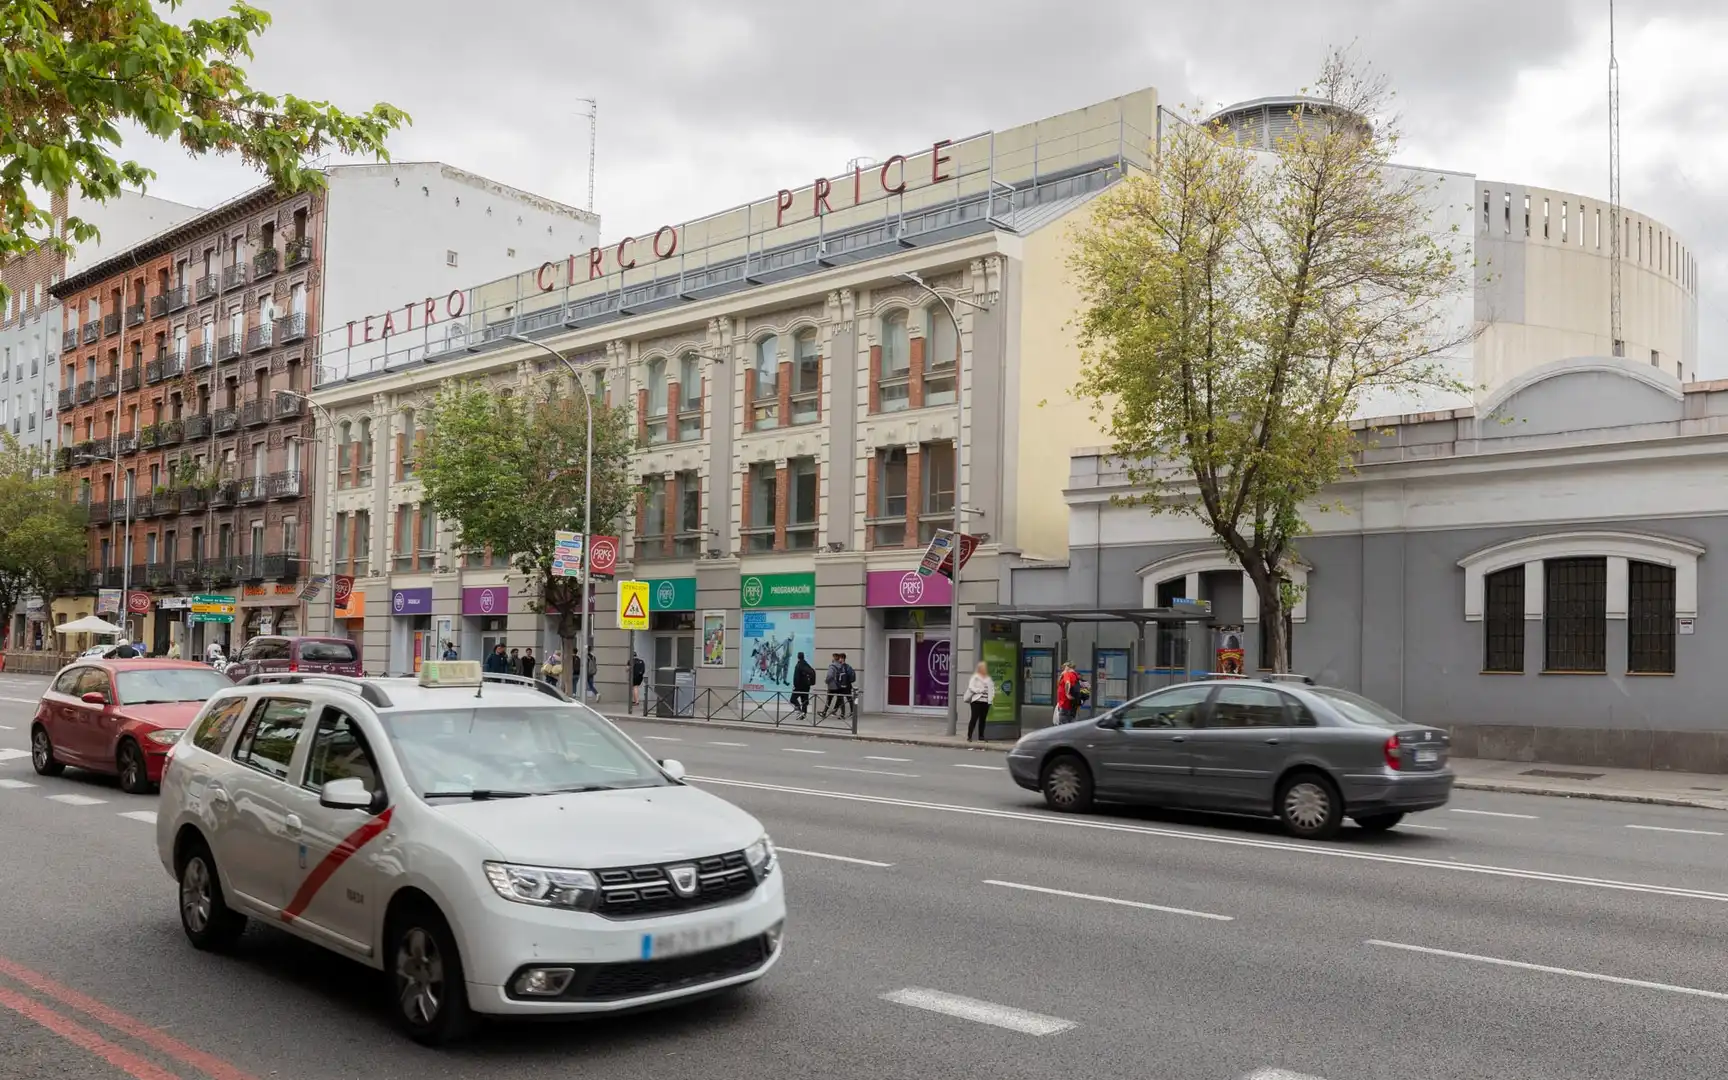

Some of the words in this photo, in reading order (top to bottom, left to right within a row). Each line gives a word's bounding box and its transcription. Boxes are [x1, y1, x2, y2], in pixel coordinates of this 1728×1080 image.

[346, 290, 465, 348] TEATRO
[537, 225, 678, 292] CIRCO
[777, 139, 952, 228] PRICE
[770, 584, 811, 595] PROGRAMACIÓN
